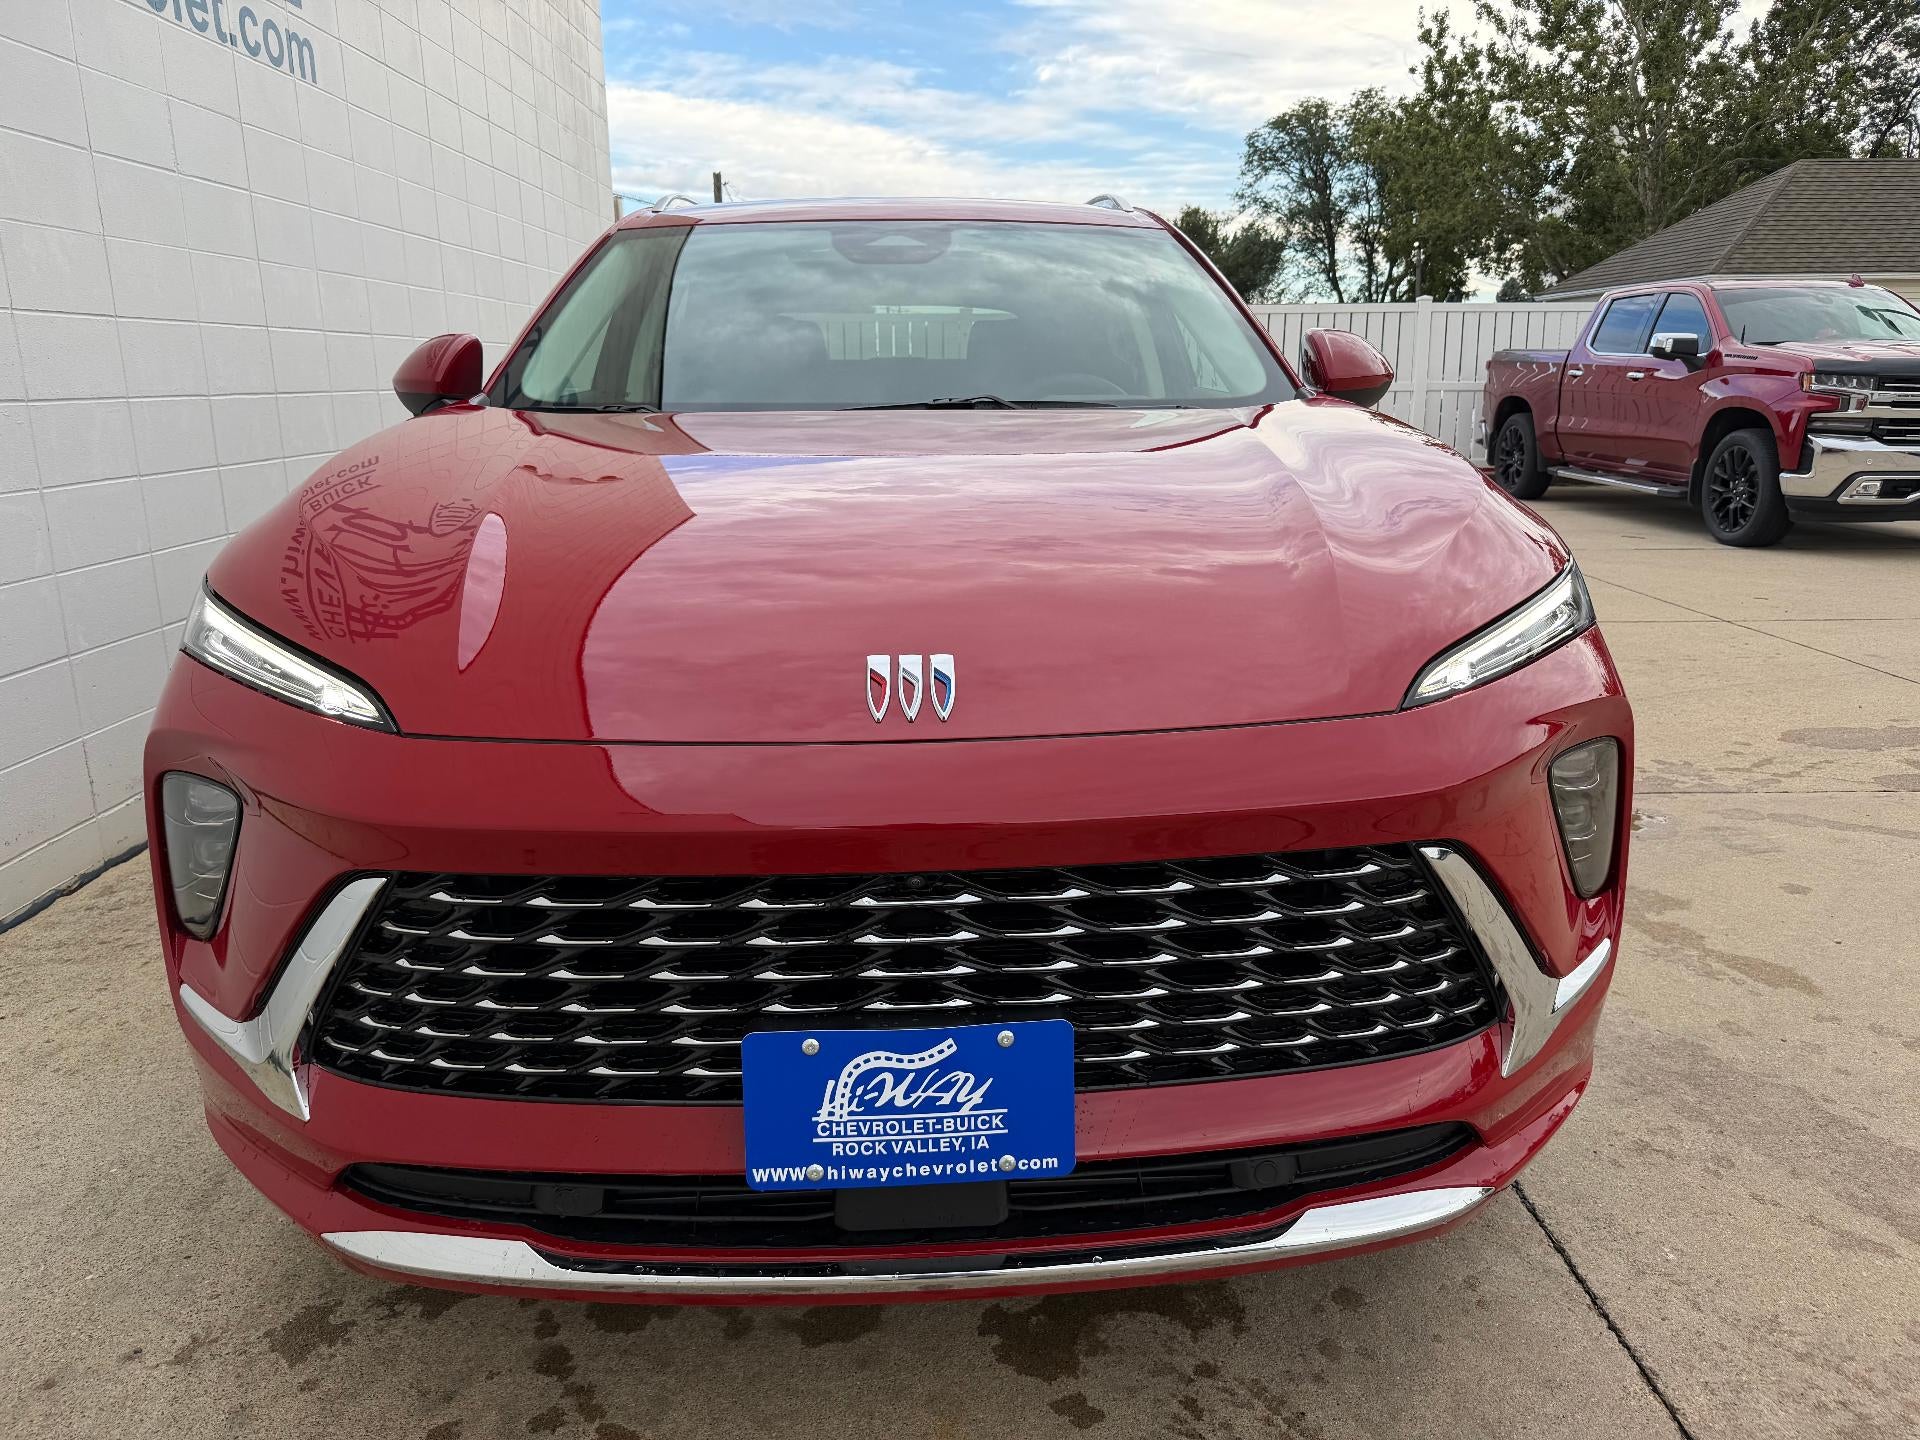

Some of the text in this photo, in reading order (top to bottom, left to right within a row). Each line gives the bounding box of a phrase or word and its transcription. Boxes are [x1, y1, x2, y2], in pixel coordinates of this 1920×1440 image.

[817, 1114, 1005, 1136] CHEVROLET-BUICK
[832, 1136, 990, 1156] ROCK VALLEY, IA
[752, 1156, 1058, 1183] wwwhiwaychevroletcom
